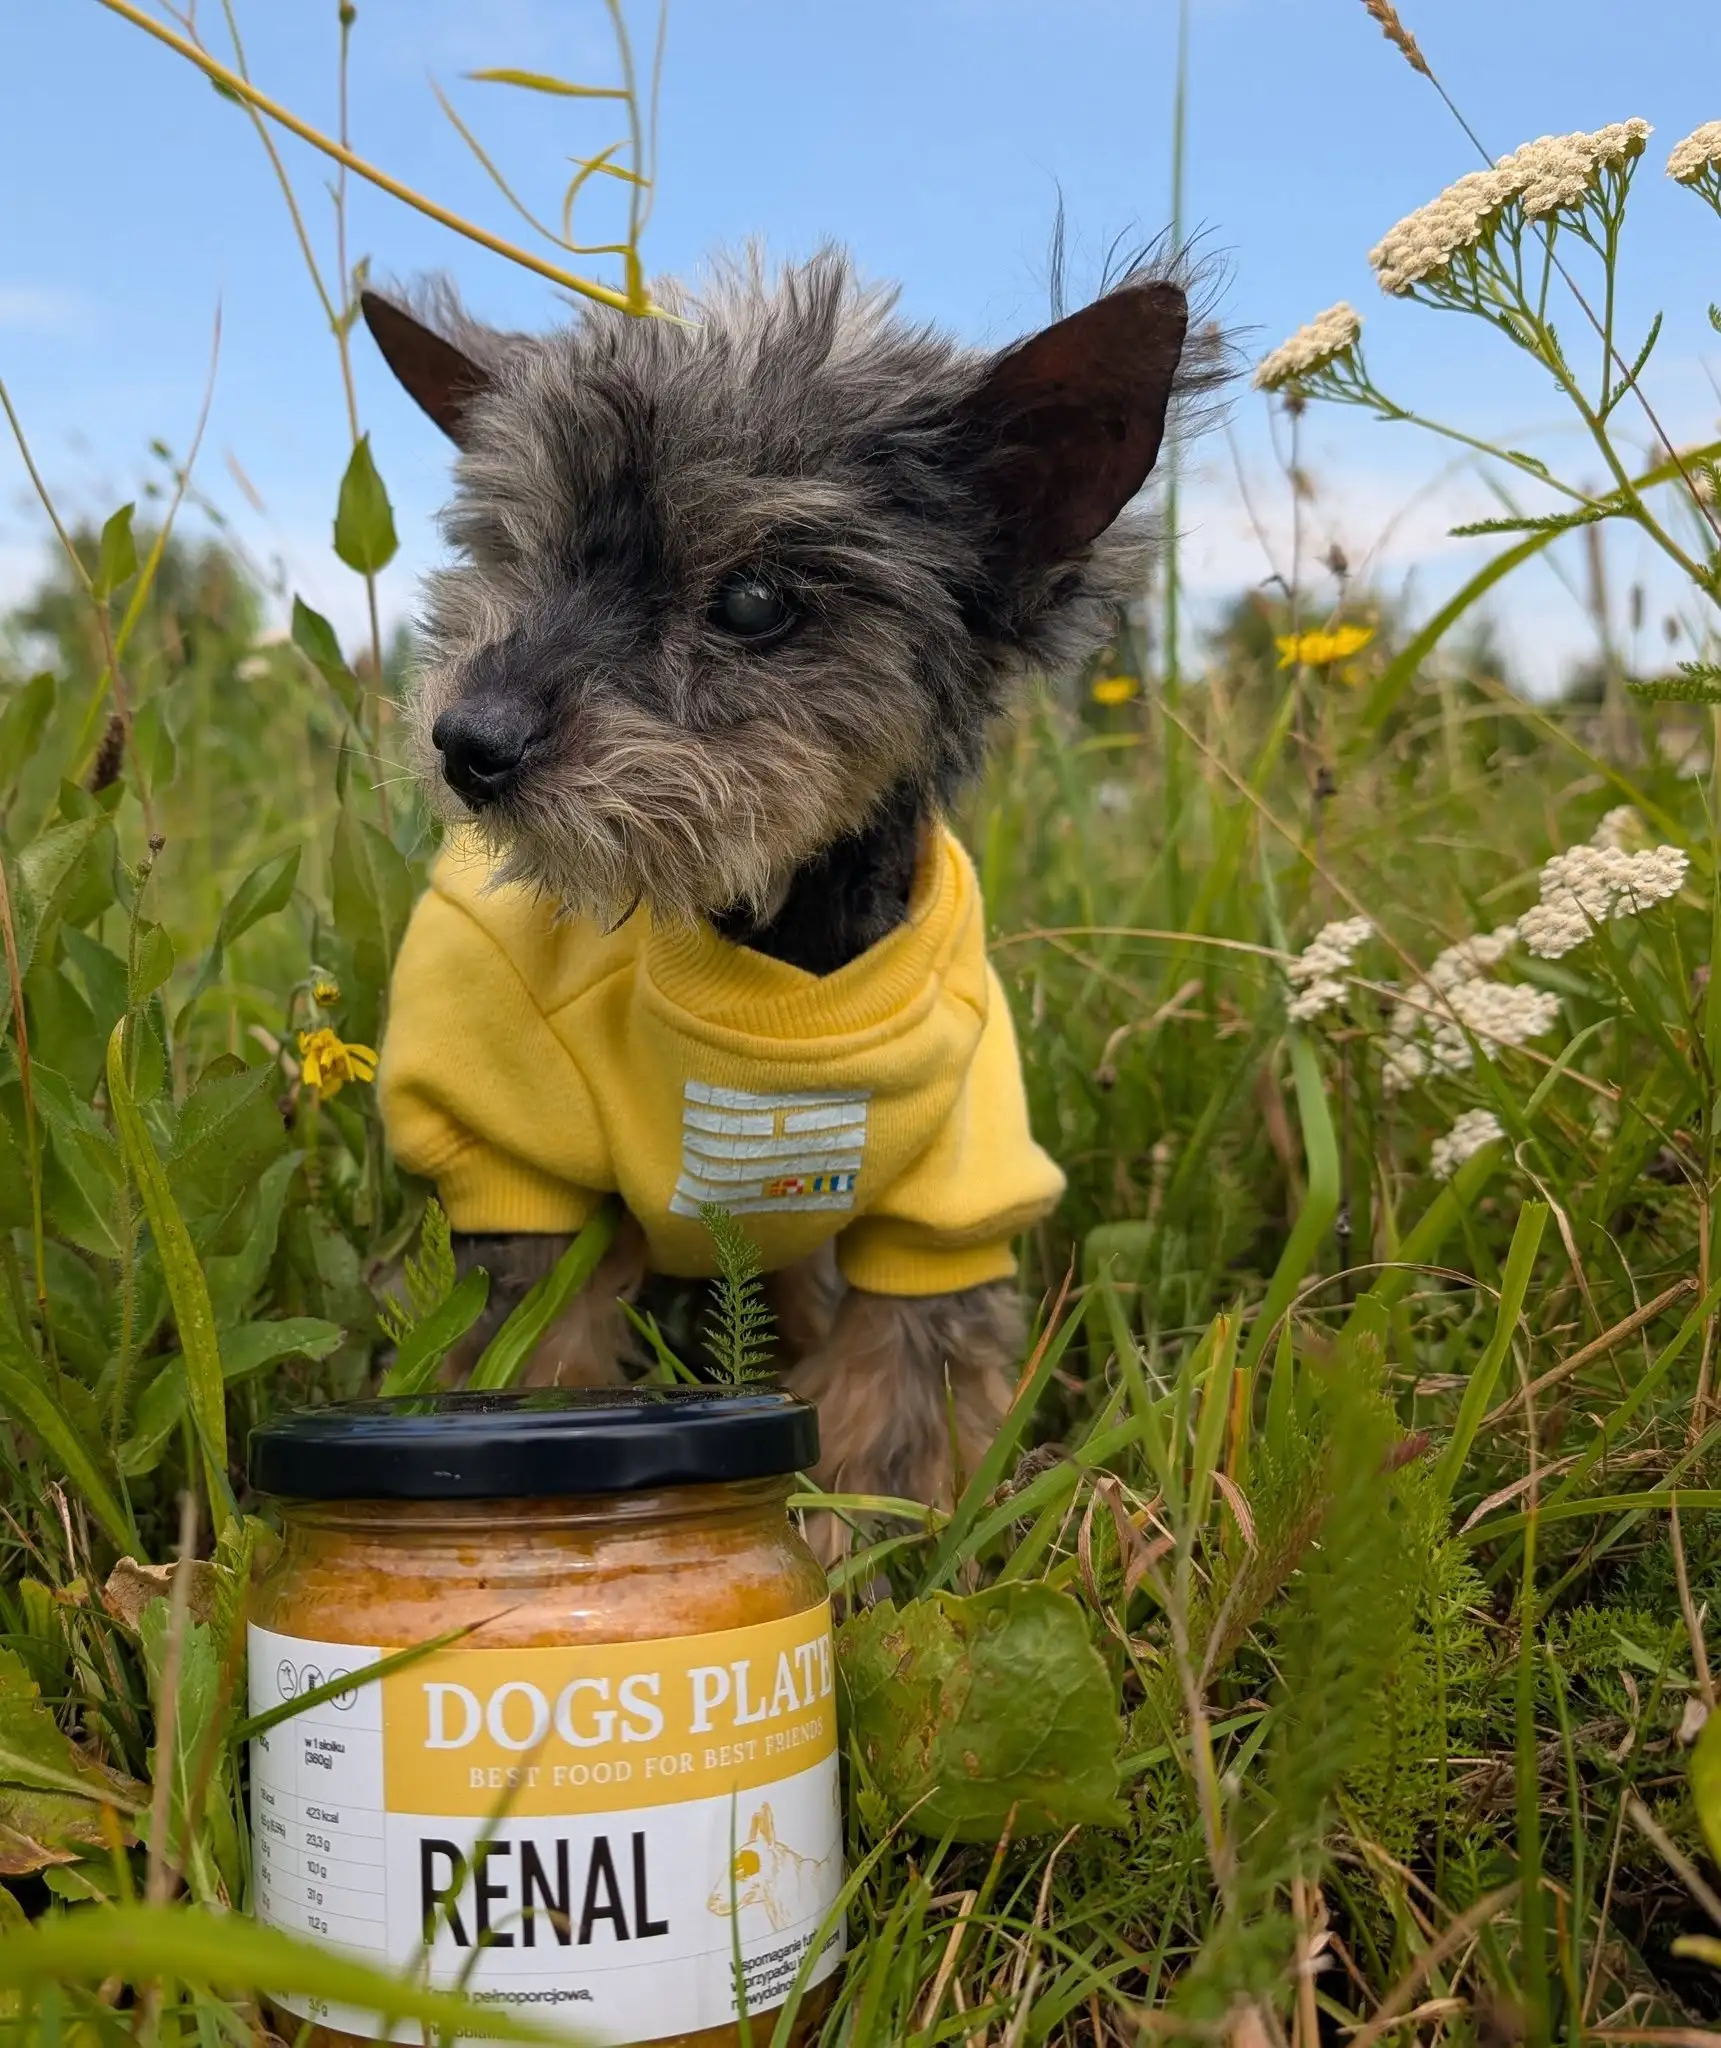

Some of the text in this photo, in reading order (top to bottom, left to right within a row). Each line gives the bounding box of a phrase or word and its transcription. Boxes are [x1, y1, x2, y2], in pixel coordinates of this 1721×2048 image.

[422, 1632, 833, 1751] DOGS PLATE
[468, 1715, 824, 1789] BEST FOOD FOR BEST FRIENDS
[321, 1809, 340, 1824] kcal
[323, 1839, 332, 1853] g
[320, 1865, 328, 1879] g
[420, 1830, 669, 1948] RENAL
[316, 1892, 324, 1905] g
[320, 1921, 329, 1934] g
